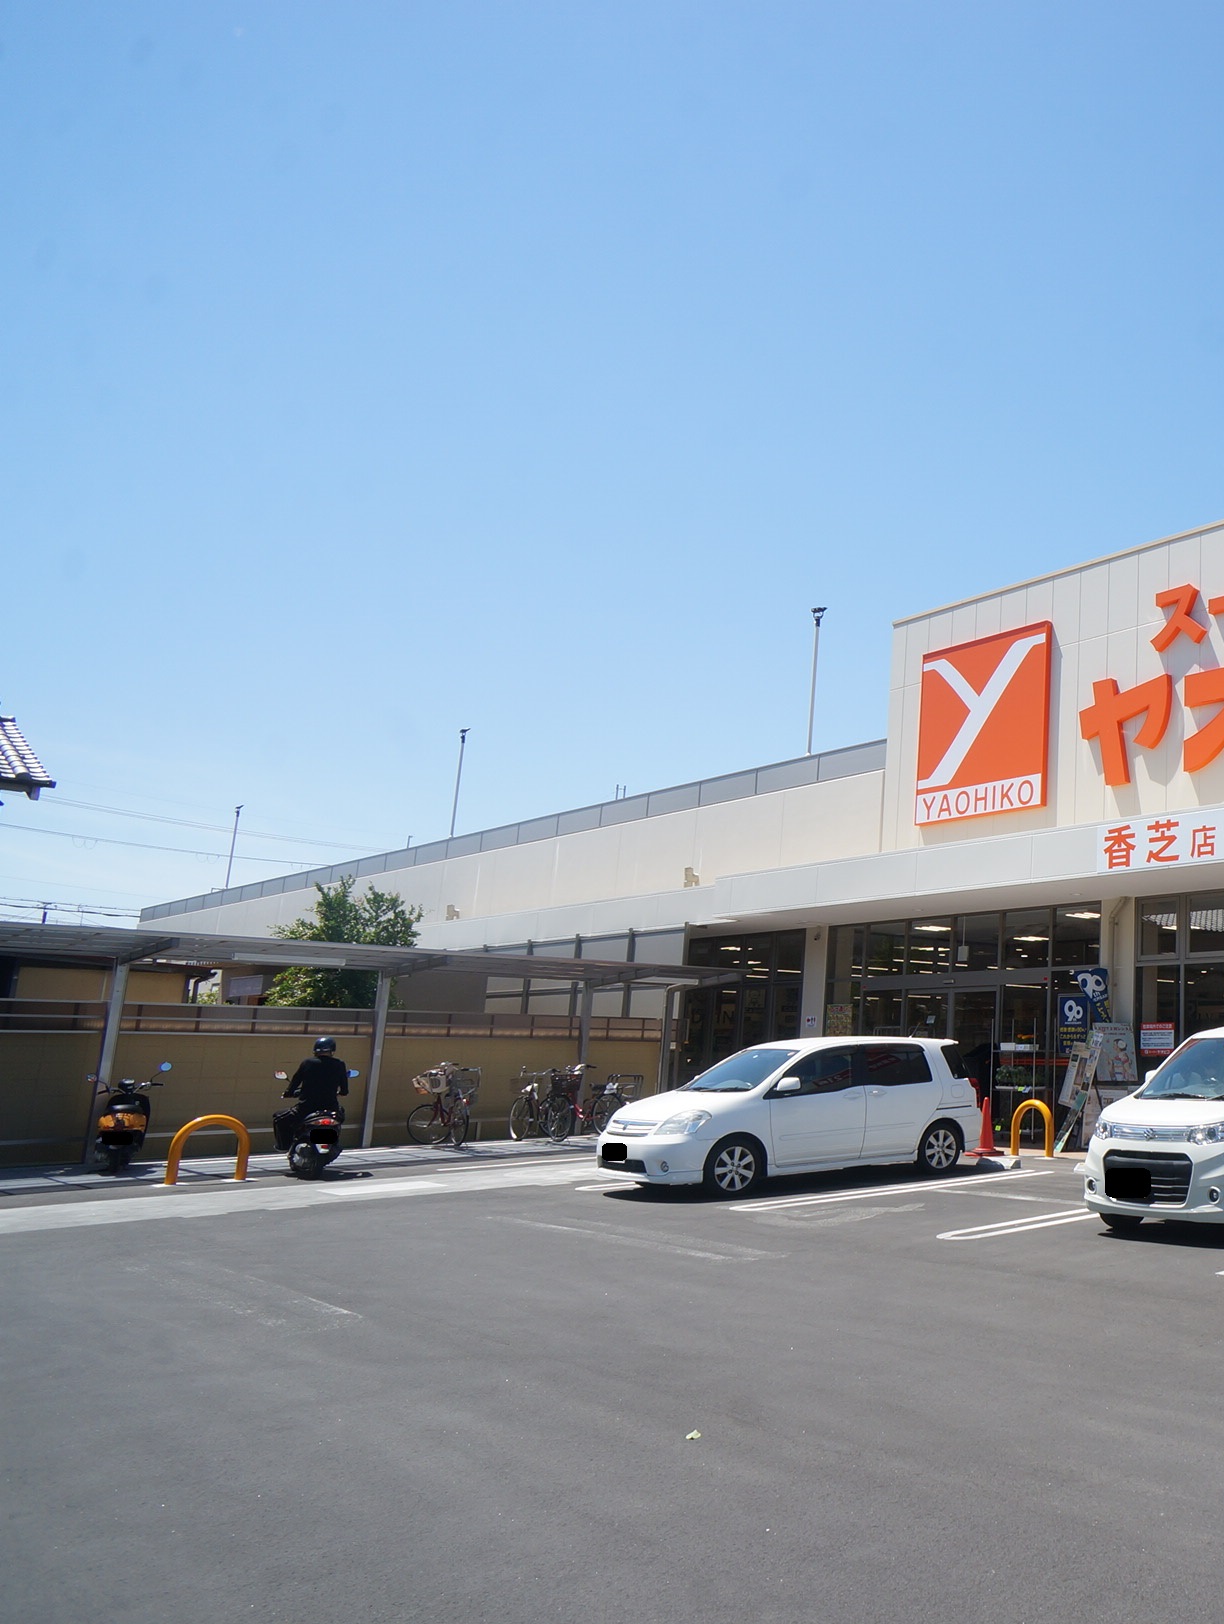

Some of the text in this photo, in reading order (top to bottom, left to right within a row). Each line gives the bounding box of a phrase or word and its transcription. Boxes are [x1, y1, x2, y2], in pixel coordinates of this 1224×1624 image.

[922, 779, 1035, 821] YAOHIKO
[1103, 819, 1217, 870] 香芝店
